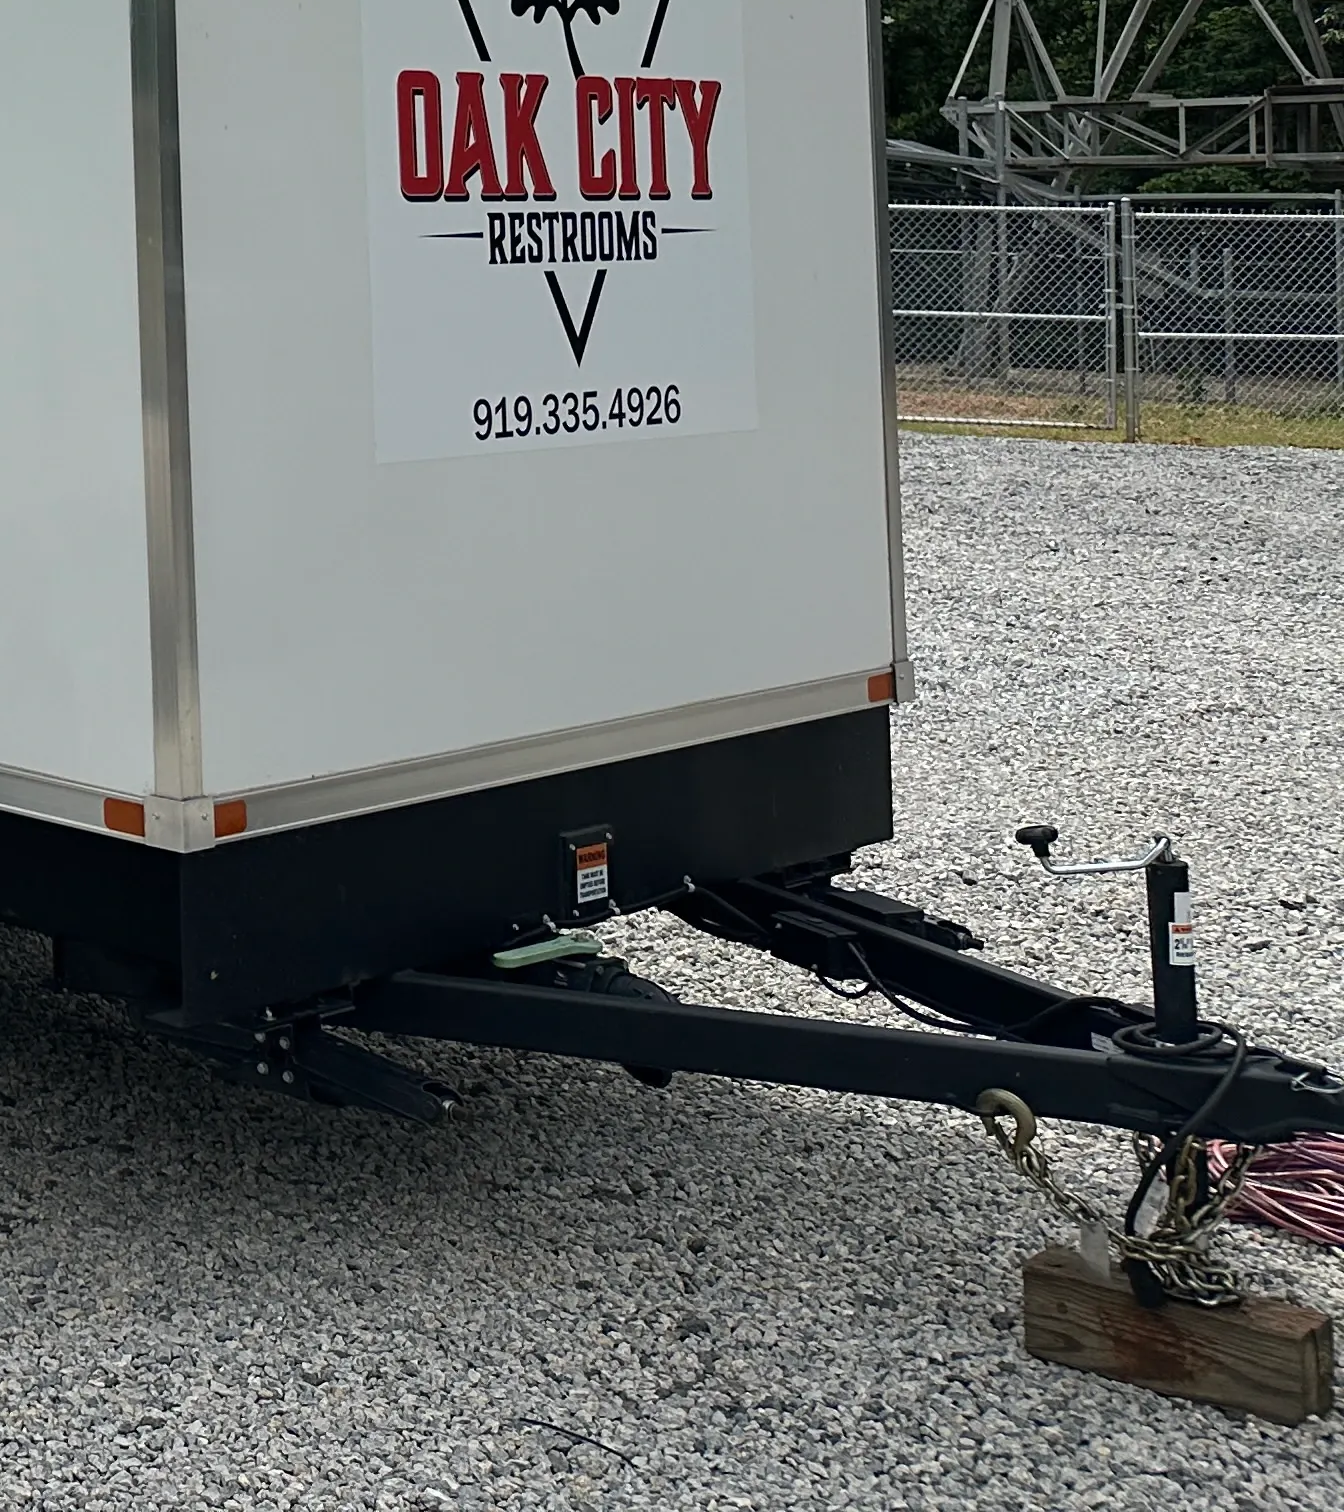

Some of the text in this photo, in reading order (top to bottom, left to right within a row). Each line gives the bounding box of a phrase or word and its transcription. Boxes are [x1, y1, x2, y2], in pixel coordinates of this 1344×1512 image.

[397, 70, 721, 202] OAK CITY
[487, 211, 658, 264] RESTROOMS
[473, 384, 682, 440] 919.335.4926
